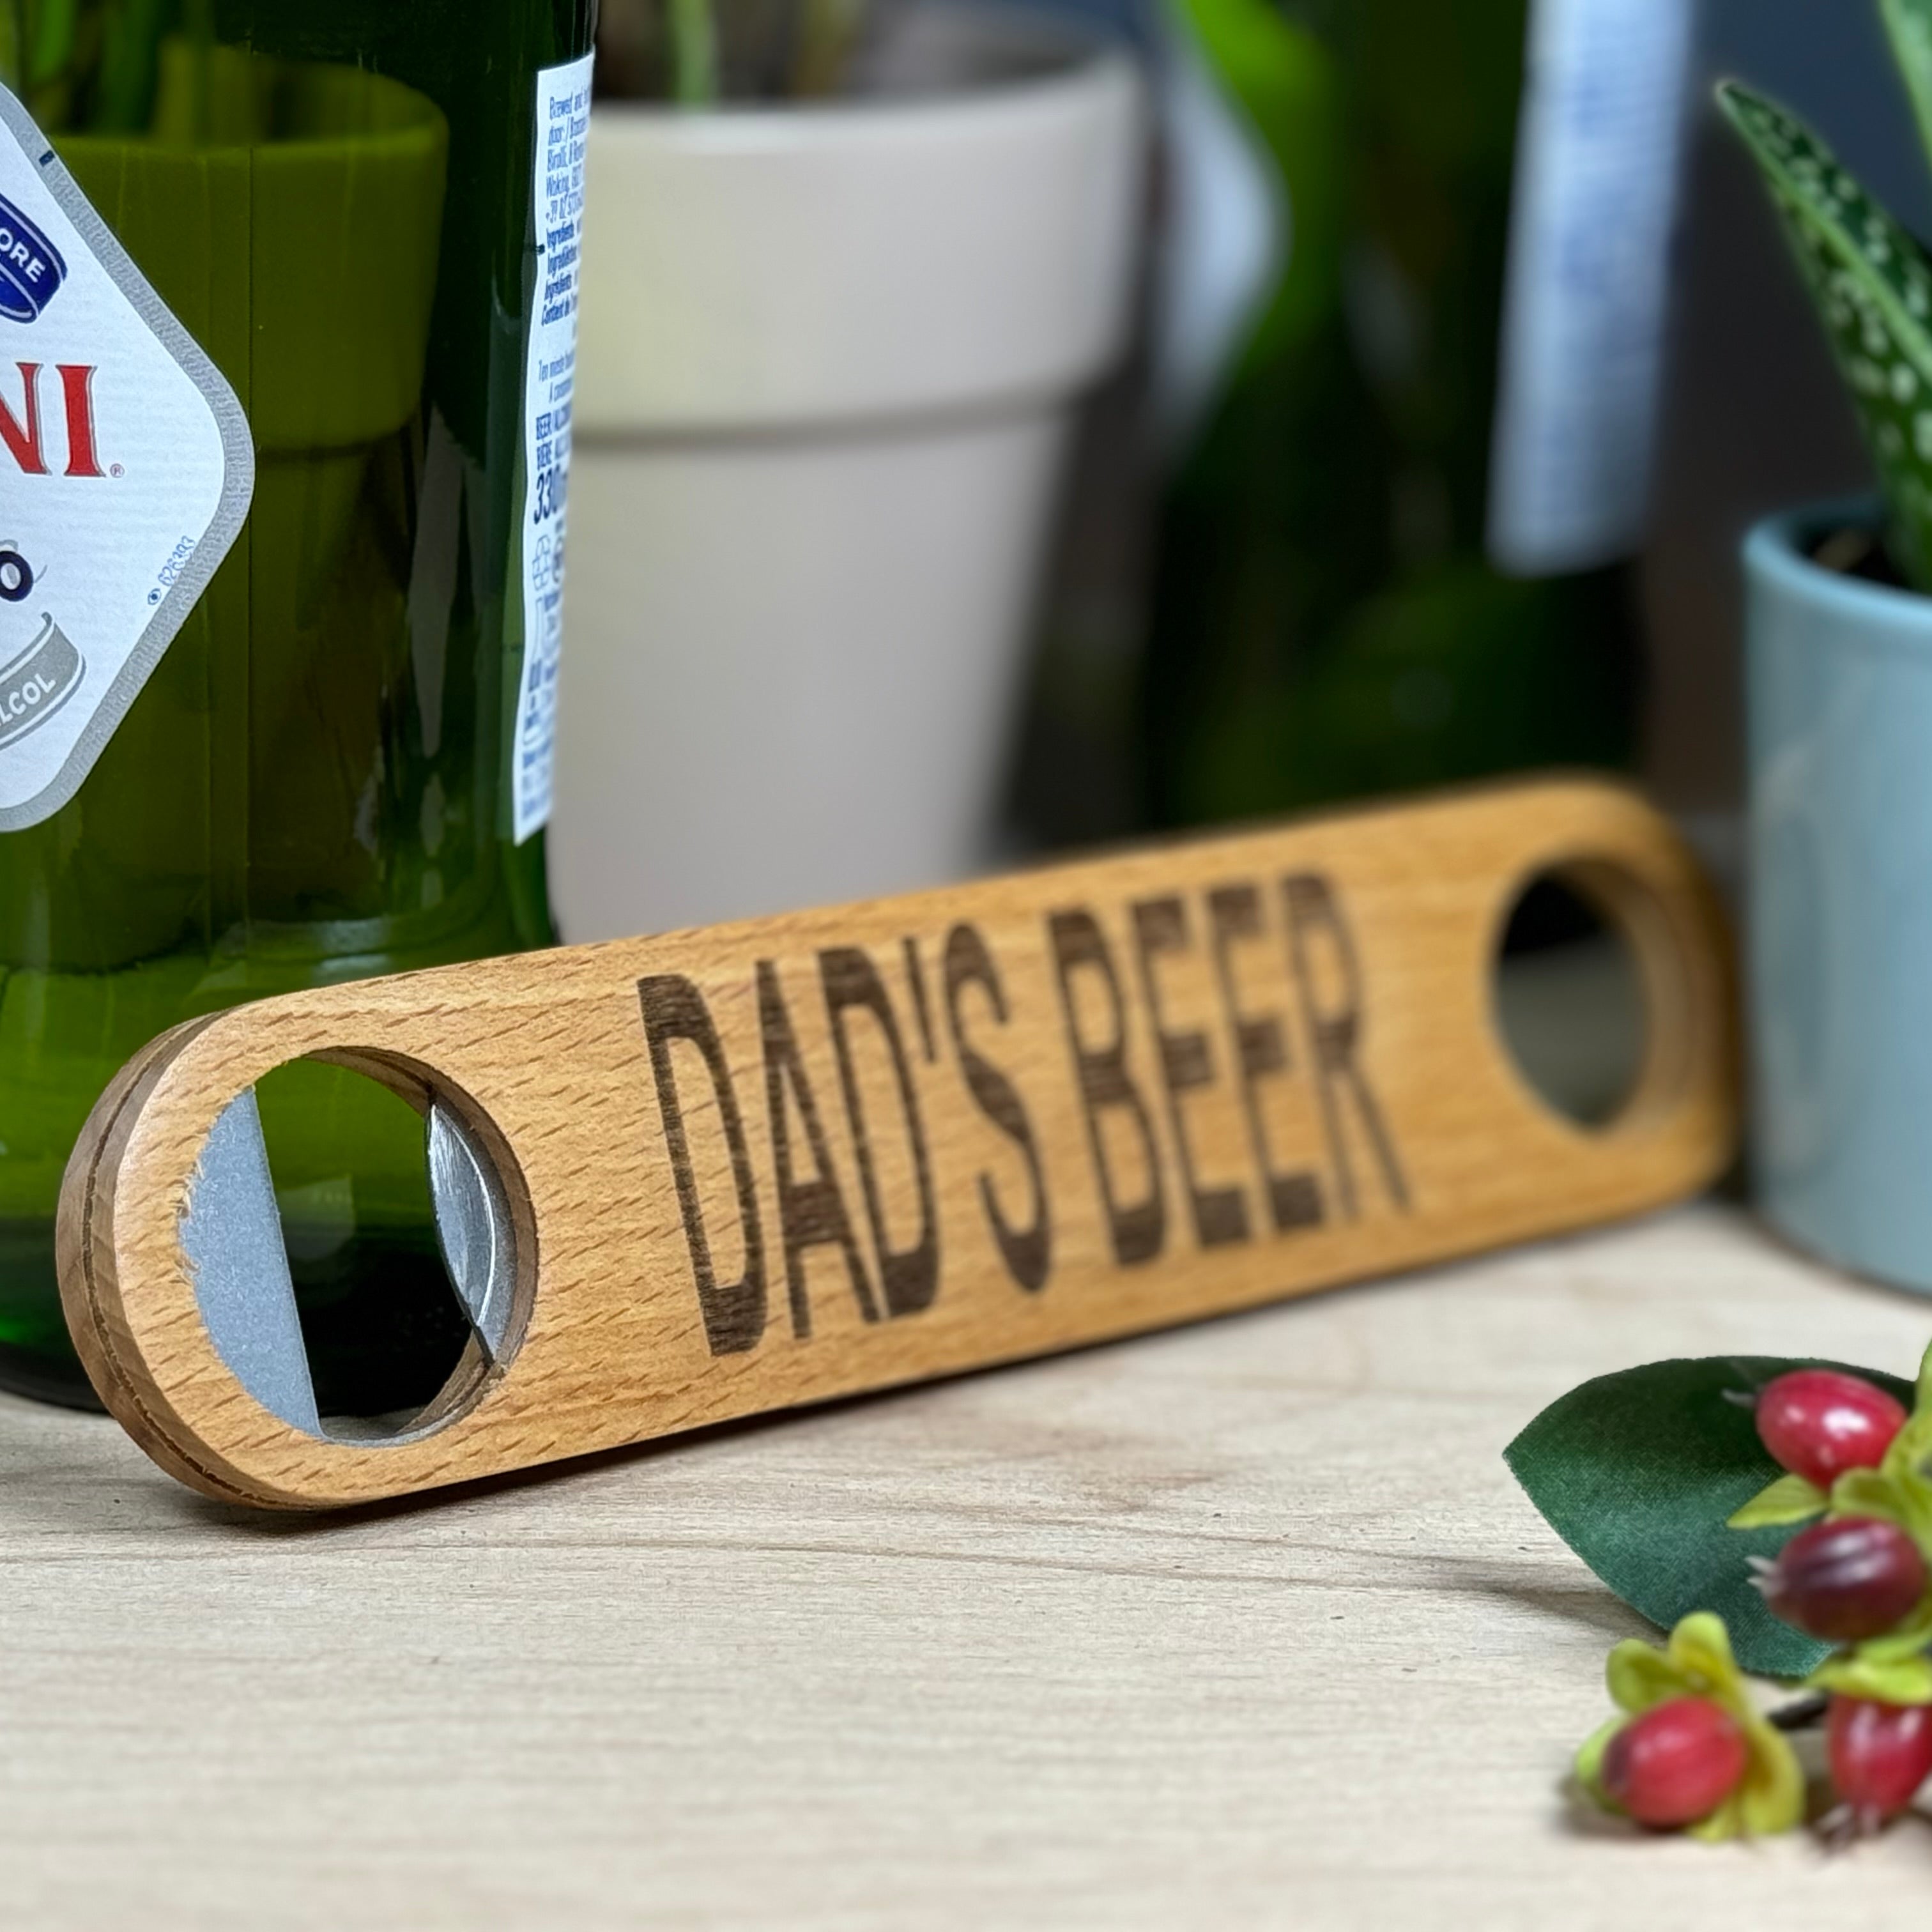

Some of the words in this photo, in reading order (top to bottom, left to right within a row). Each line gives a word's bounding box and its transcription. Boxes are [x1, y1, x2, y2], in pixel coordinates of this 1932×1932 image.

[0, 228, 46, 282] ORE
[638, 921, 1052, 1356] DAD'S
[1045, 870, 1411, 1268] BEER
